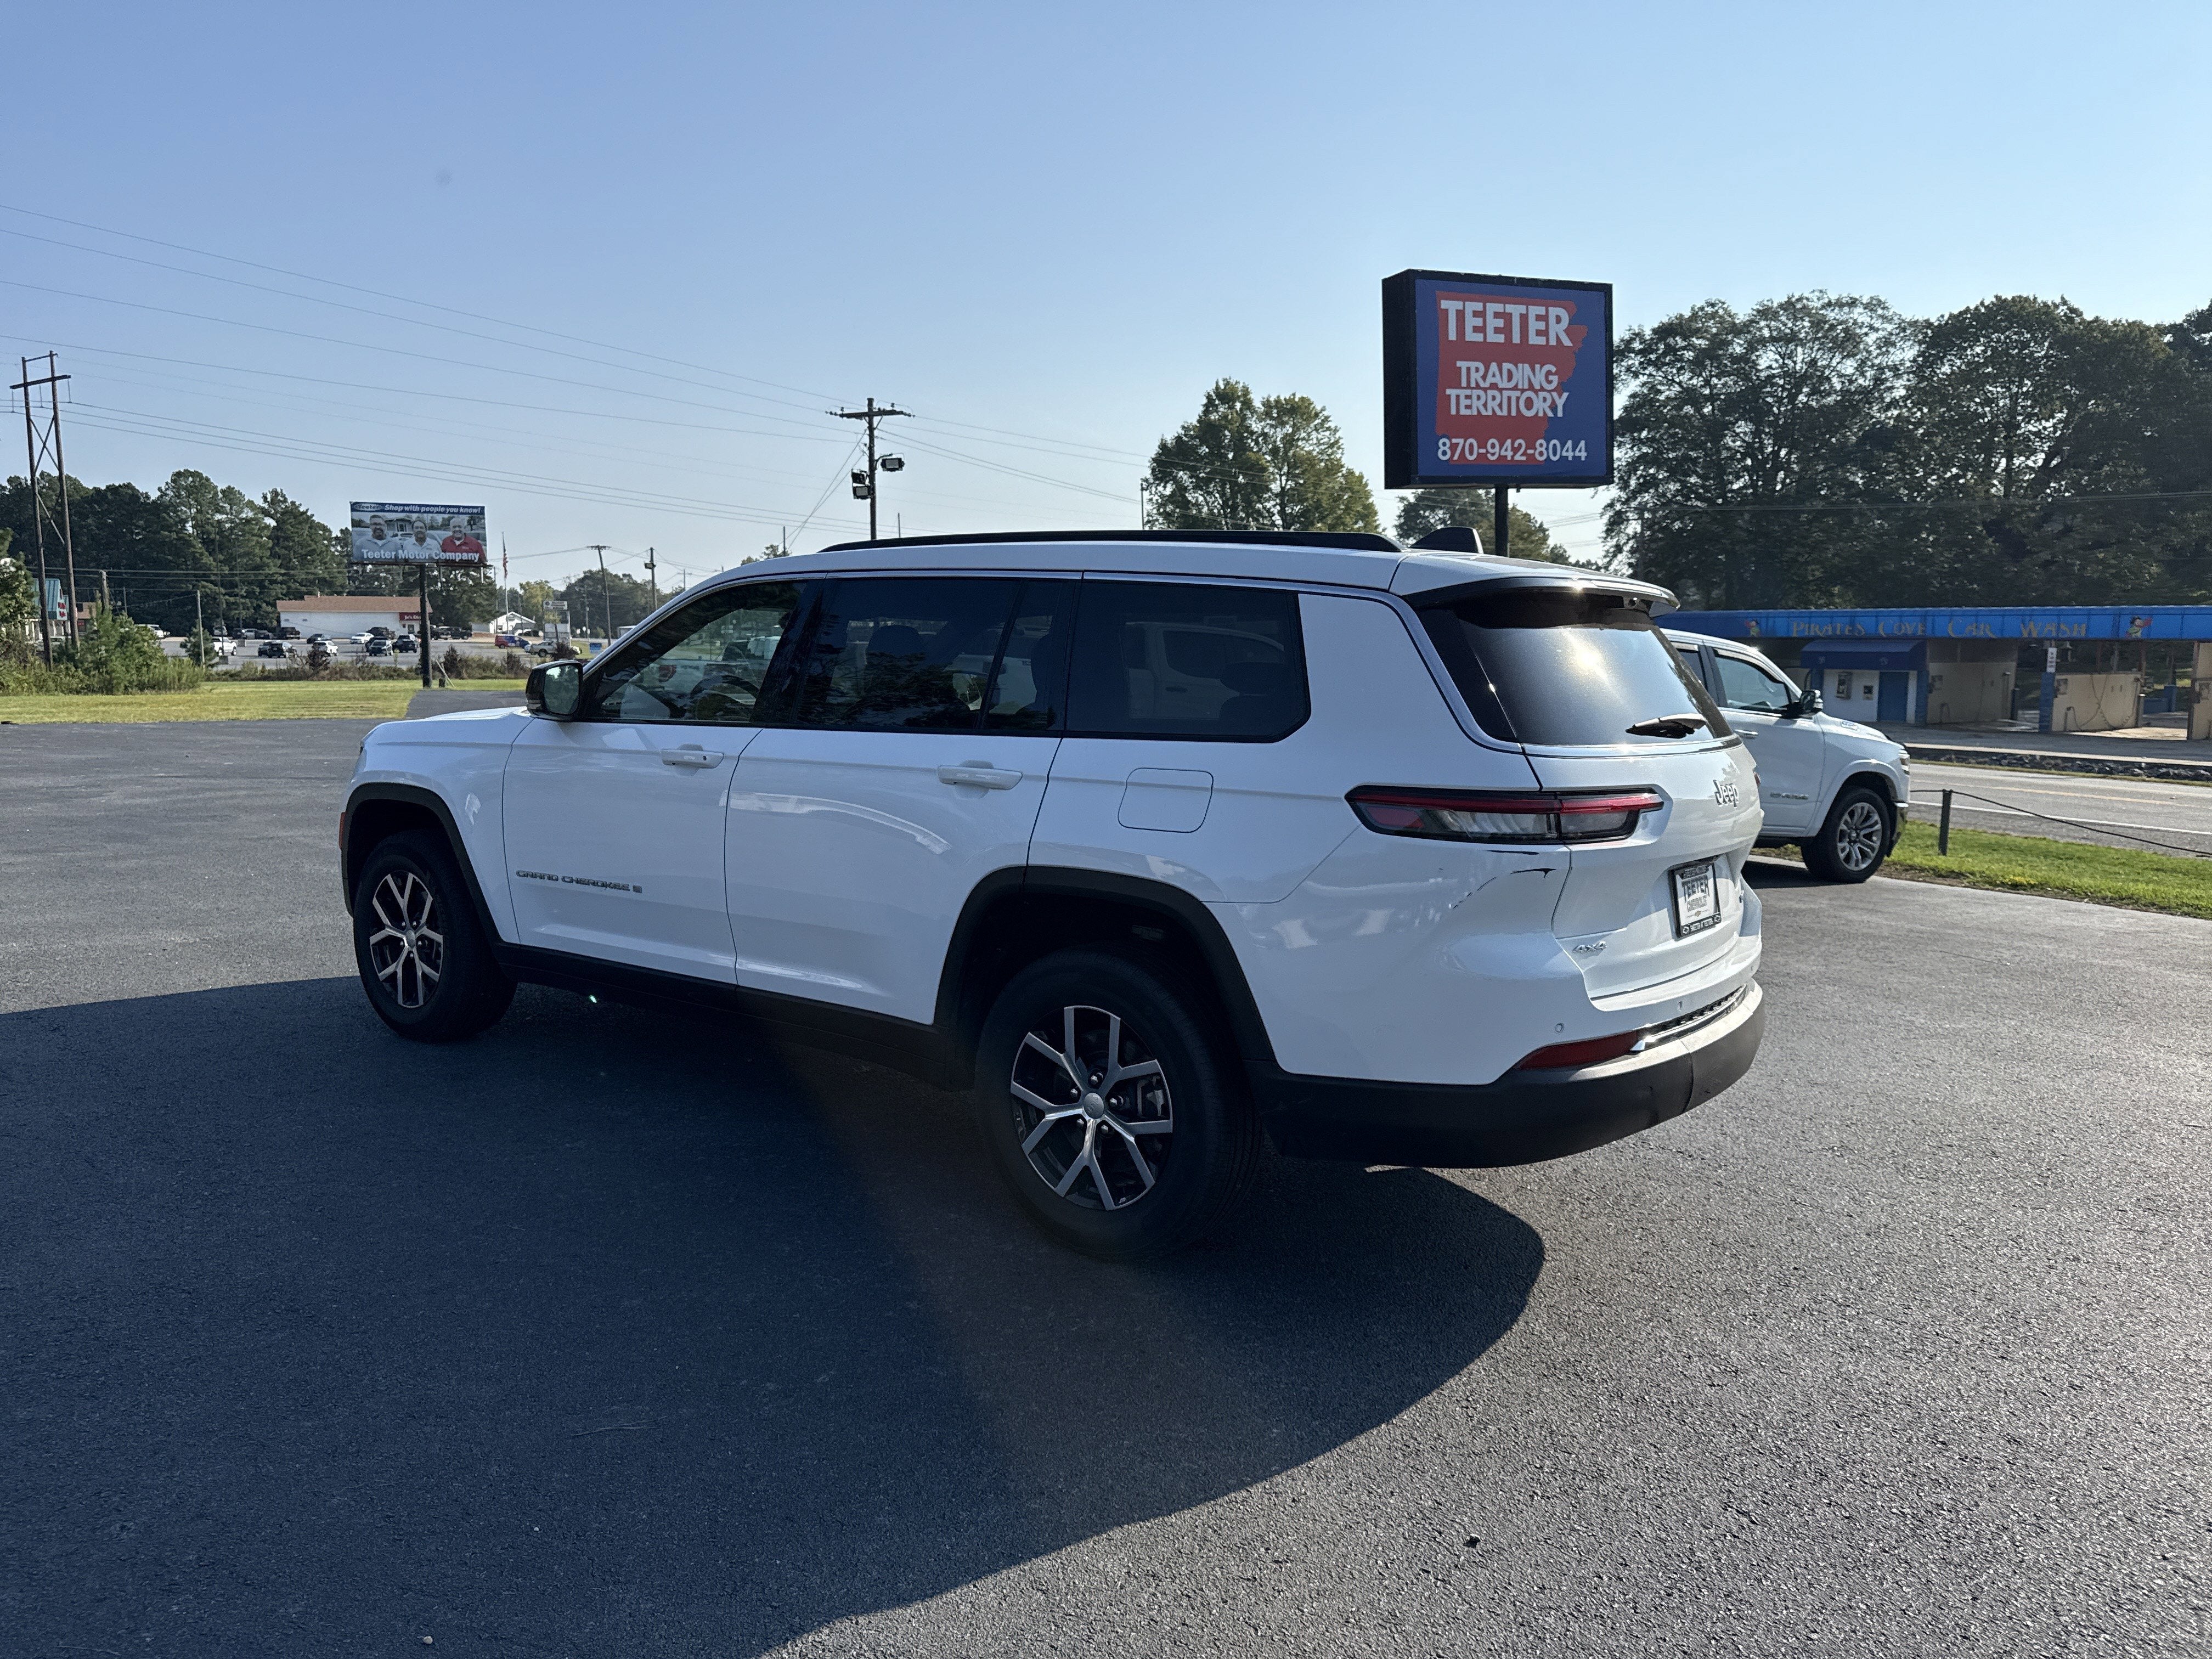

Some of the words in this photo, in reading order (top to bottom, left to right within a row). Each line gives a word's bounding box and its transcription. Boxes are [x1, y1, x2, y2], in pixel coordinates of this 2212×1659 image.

[1440, 300, 1573, 347] TEETER
[1456, 360, 1559, 390] TRADING
[1446, 388, 1569, 418] TERRITORY
[1437, 438, 1587, 461] 870-942-8044
[362, 549, 396, 559] Teeter
[398, 549, 430, 560] Motor
[432, 550, 479, 562] Company
[1878, 620, 1926, 637] COVE
[1948, 619, 1997, 637] CAR
[2020, 620, 2087, 637] WASH
[1713, 779, 1739, 808] Jeep
[515, 870, 559, 882] GRAND
[561, 876, 630, 891] CHEROKEE
[1681, 874, 1711, 904] TEETER
